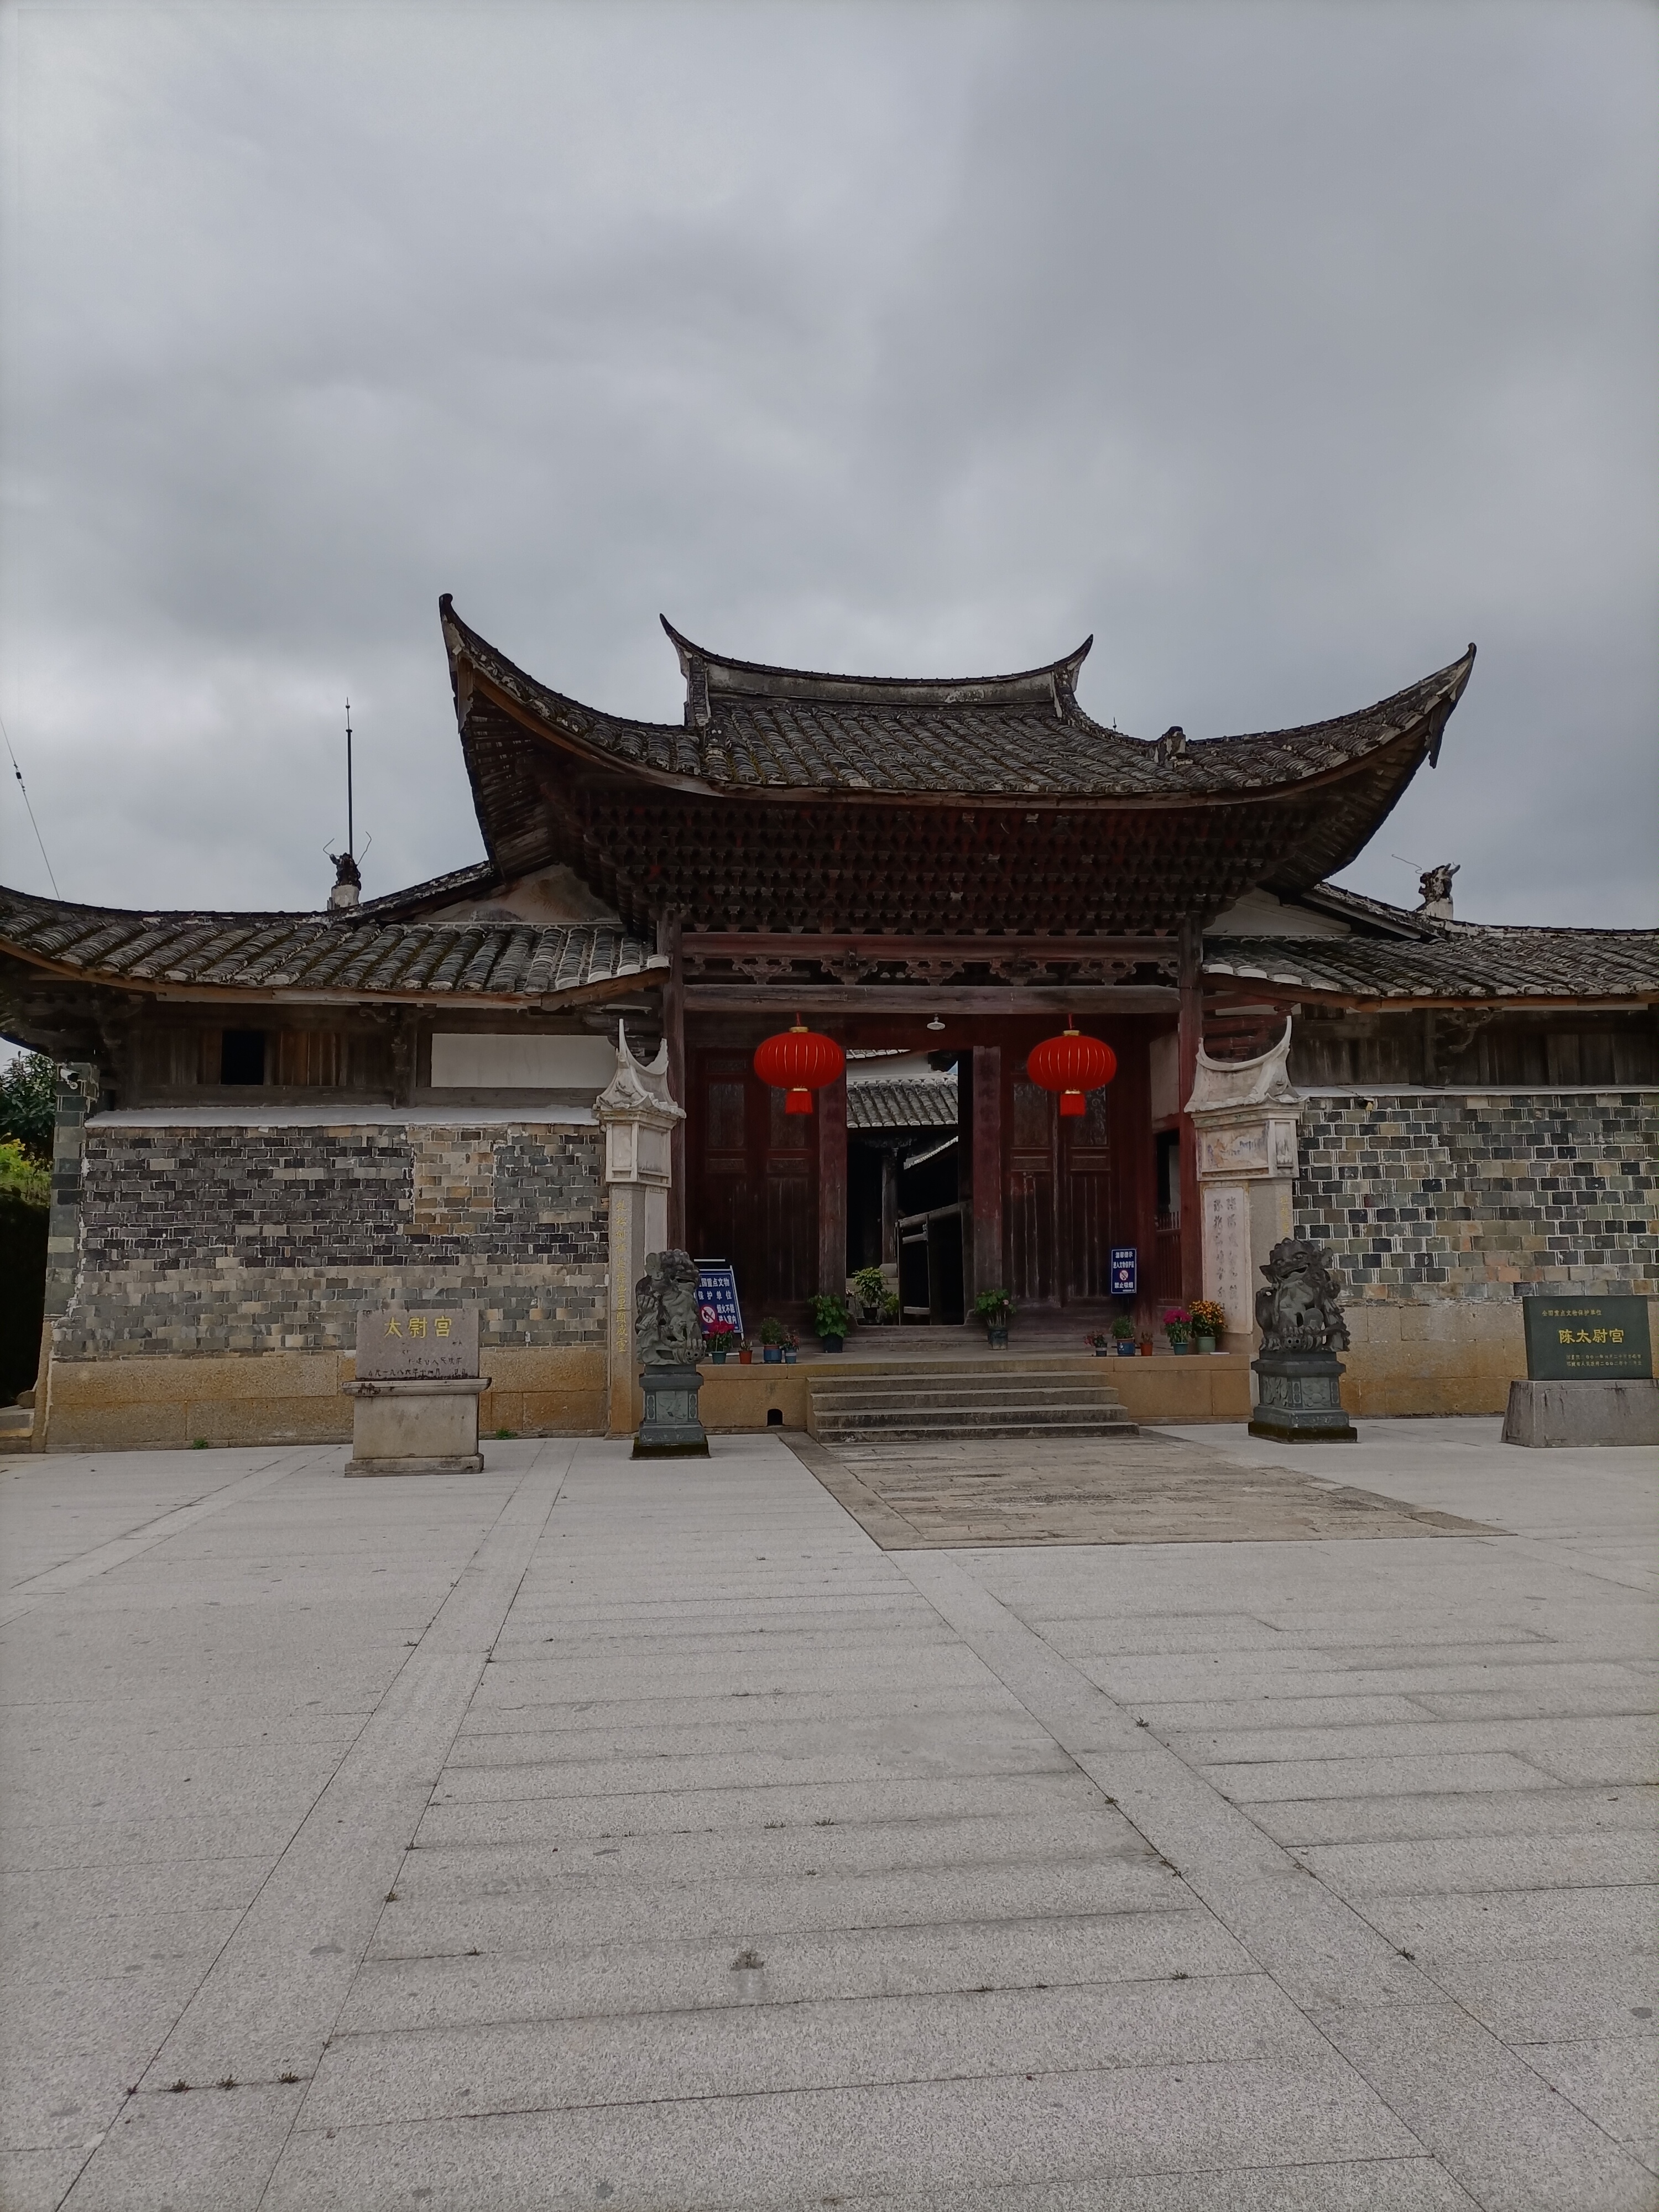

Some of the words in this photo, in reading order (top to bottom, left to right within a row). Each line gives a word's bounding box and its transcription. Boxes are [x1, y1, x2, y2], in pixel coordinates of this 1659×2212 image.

[699, 1277, 730, 1287] 国重点文物
[717, 1304, 735, 1314] 烟火不能
[384, 1315, 452, 1338] 太尉宫
[1558, 1328, 1624, 1344] 陈太尉宫
